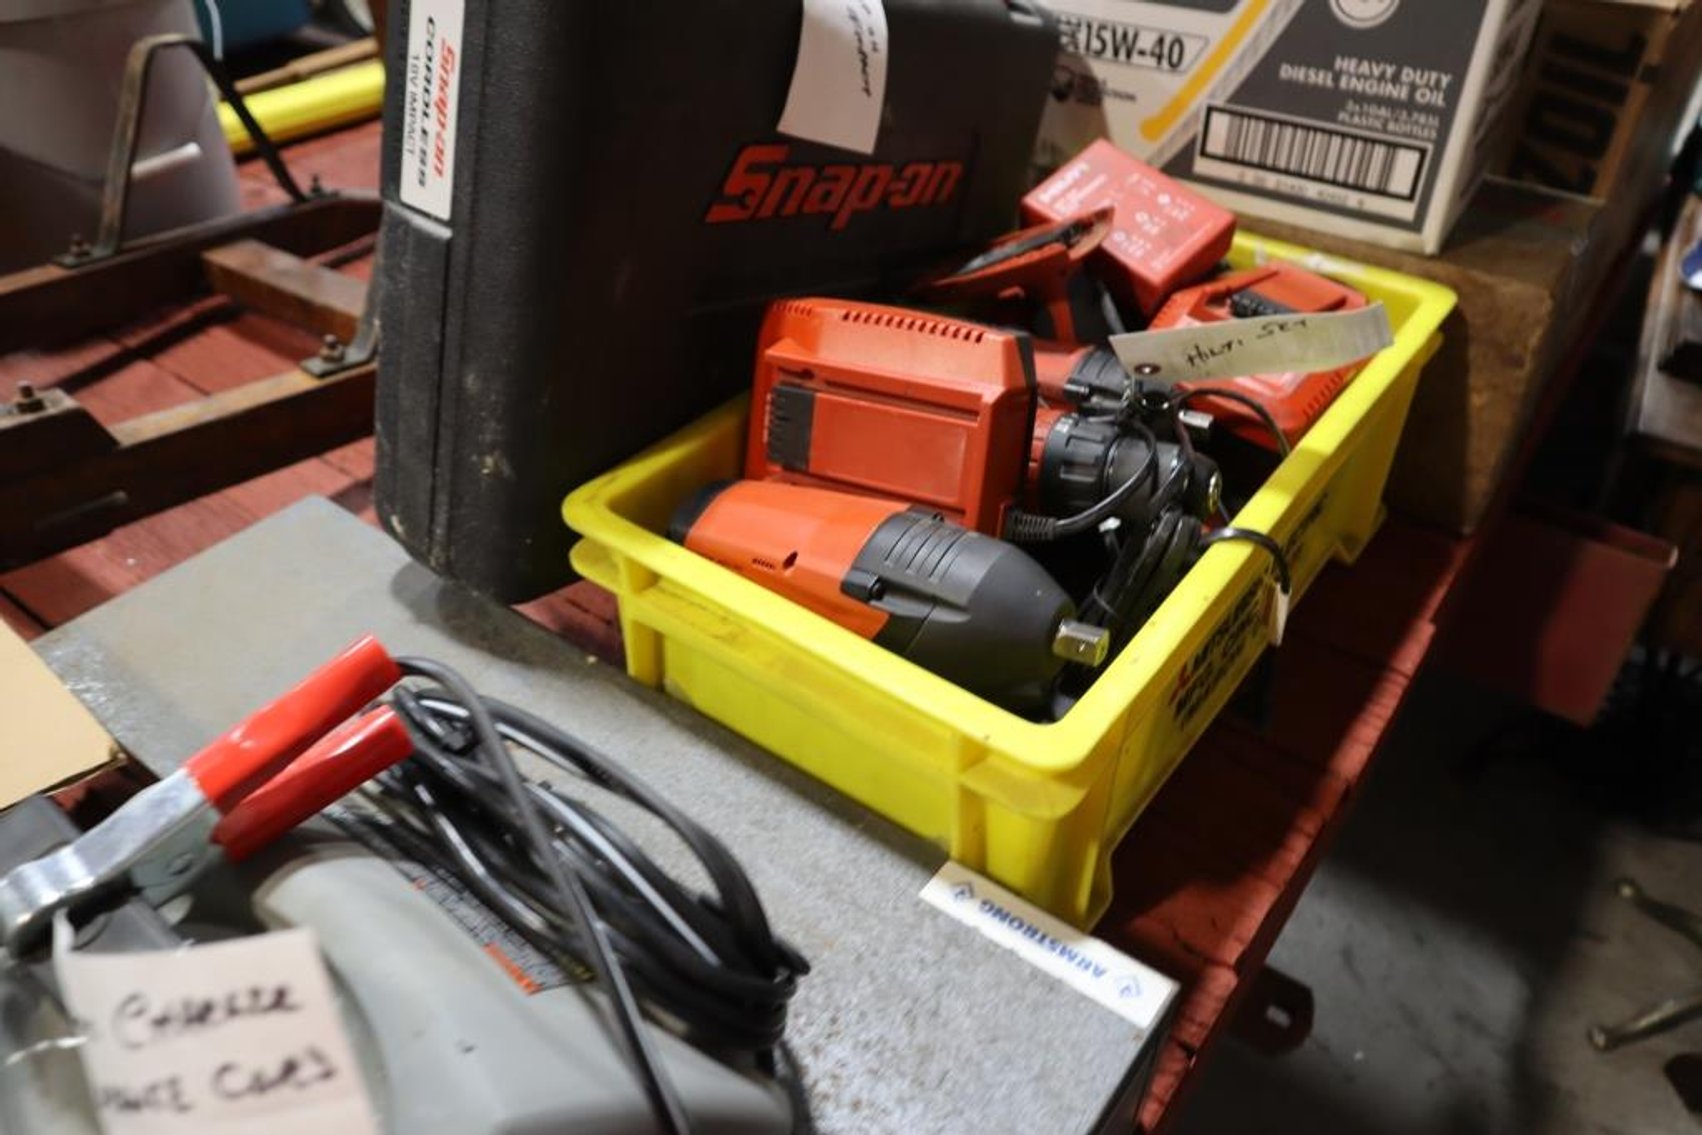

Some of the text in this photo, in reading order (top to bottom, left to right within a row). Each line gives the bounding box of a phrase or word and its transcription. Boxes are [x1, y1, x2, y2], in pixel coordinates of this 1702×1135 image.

[1084, 21, 1185, 70] 15W-40
[1333, 54, 1453, 89] HEAVY DUTY
[418, 15, 436, 188] CORDLESS
[432, 37, 455, 178] Snap-on
[1279, 62, 1446, 108] DIESEL ENGINE OIL
[406, 92, 418, 158] IMPACT
[704, 144, 963, 231] Snap-on
[979, 899, 1108, 978] ARMSTRONG
